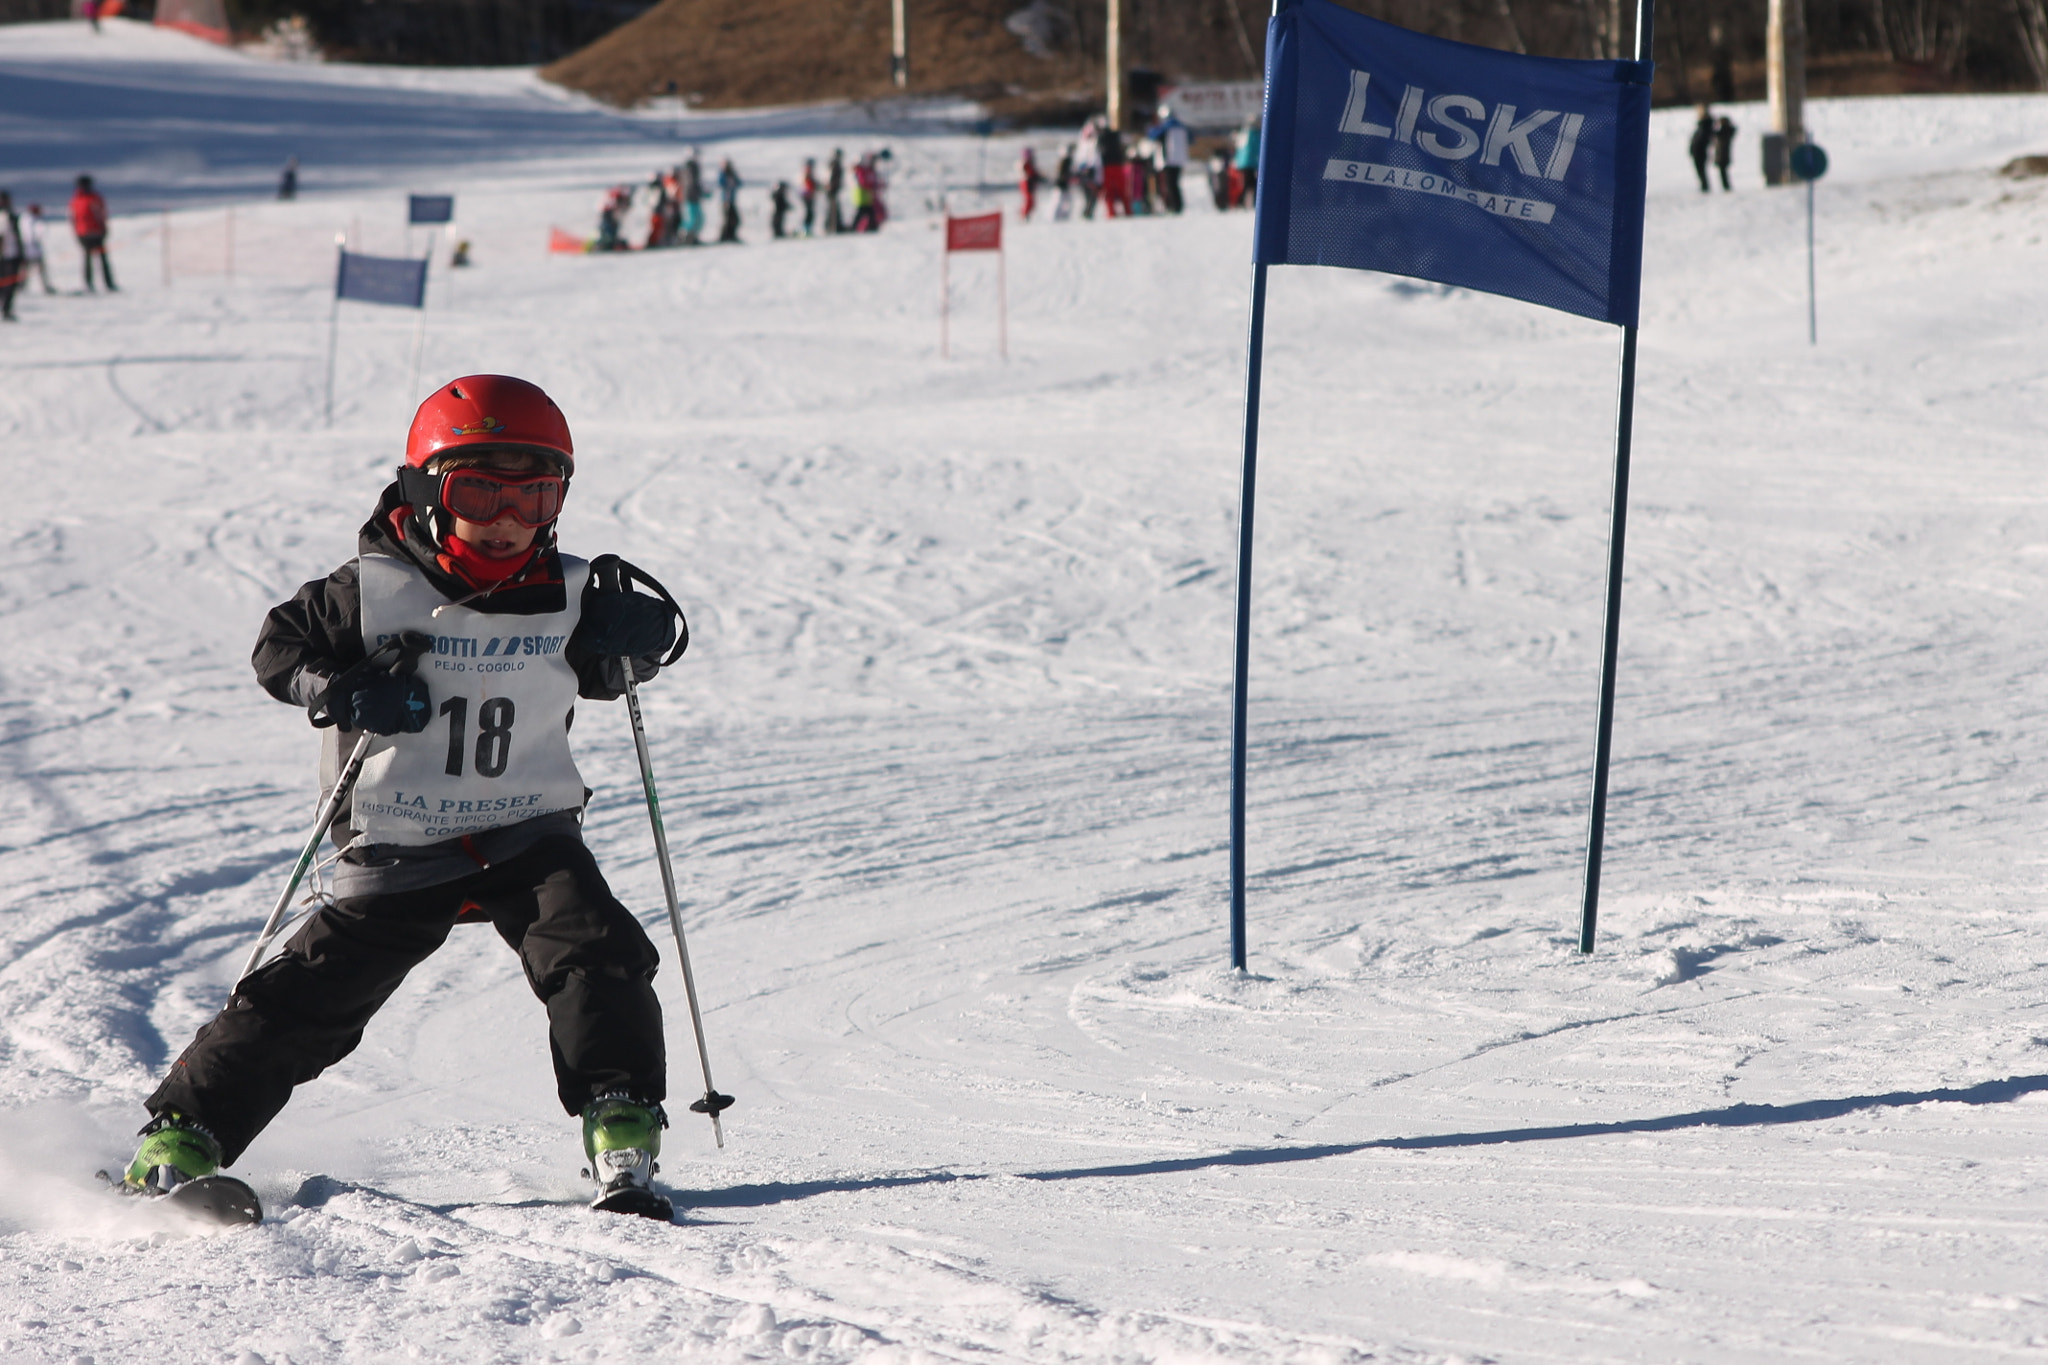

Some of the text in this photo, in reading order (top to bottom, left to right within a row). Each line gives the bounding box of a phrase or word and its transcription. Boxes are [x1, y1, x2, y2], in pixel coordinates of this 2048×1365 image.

[1338, 69, 1585, 182] LISKI
[1344, 164, 1457, 196] SLALOM
[376, 633, 566, 658] CROTTI SPORT
[434, 660, 466, 673] PEJO
[477, 661, 525, 673] COGOLO
[439, 695, 516, 778] 18
[361, 801, 450, 826] RISTORANTE
[454, 813, 497, 825] TIPICO
[393, 791, 543, 814] LA PRESEF
